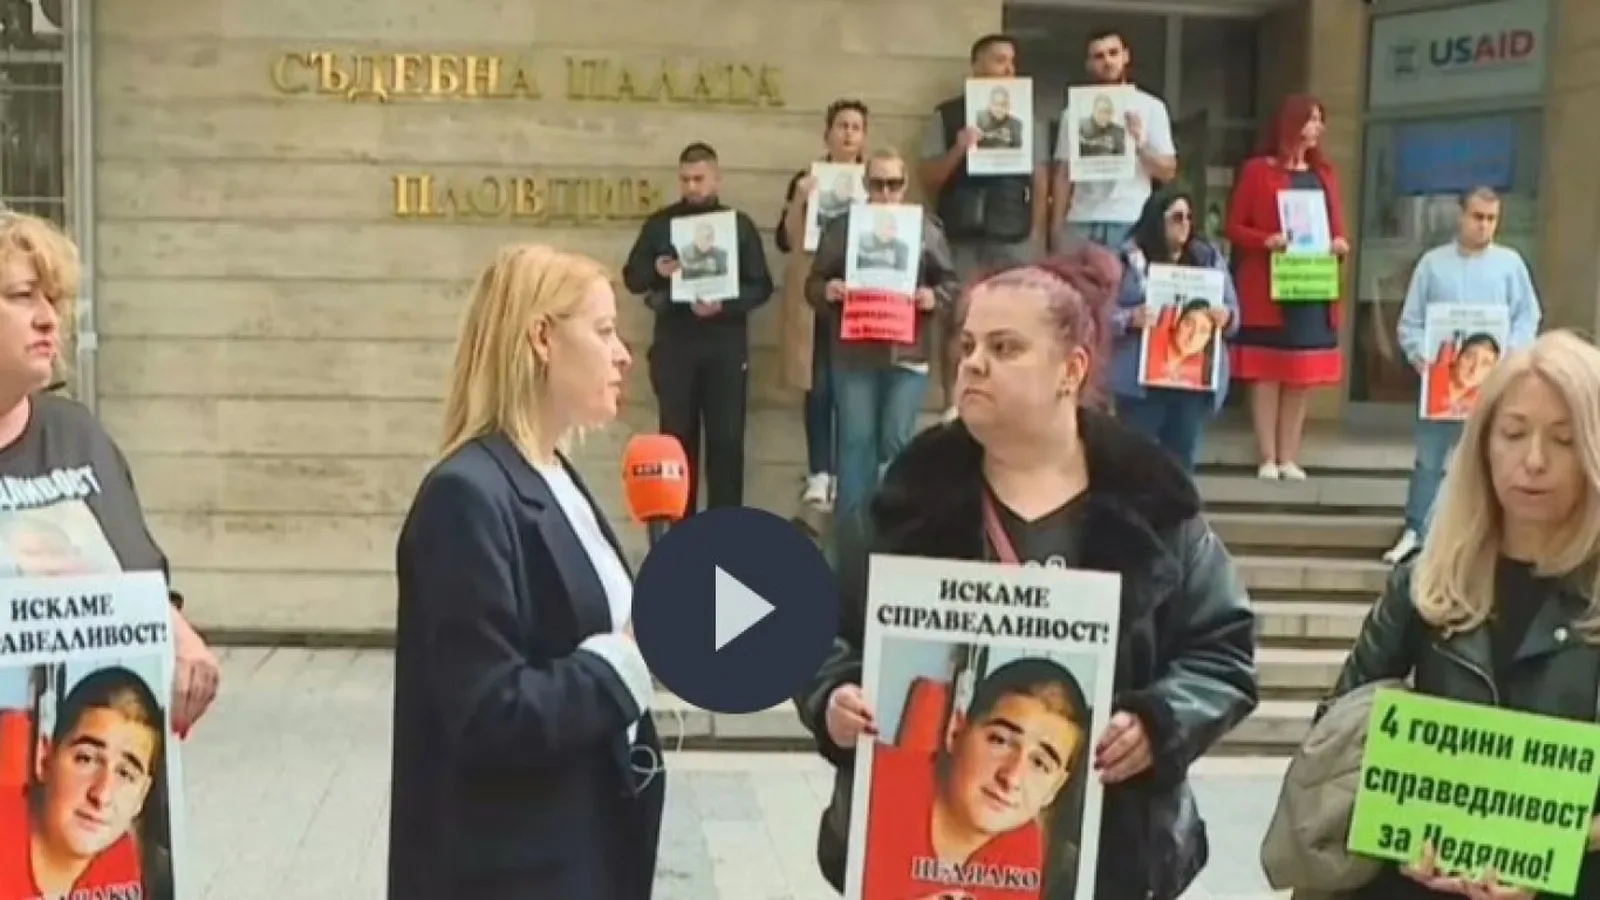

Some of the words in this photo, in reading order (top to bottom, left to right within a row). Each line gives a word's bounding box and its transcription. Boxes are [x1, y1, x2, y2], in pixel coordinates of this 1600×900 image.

[1429, 29, 1535, 66] USAID
[270, 50, 541, 103] СЪДЕБНА
[11, 593, 114, 622] ИСКАМЕ
[939, 578, 1050, 609] ИСКАМЕ
[0, 622, 167, 654] АВЕДЛИВОСТ!
[877, 604, 1110, 646] СПРАВЕДЛИВОСТ!
[1379, 702, 1399, 740] 4
[1408, 717, 1515, 760] години
[1523, 738, 1596, 774] няма
[1364, 765, 1590, 830] справедливост
[1377, 823, 1412, 853] за
